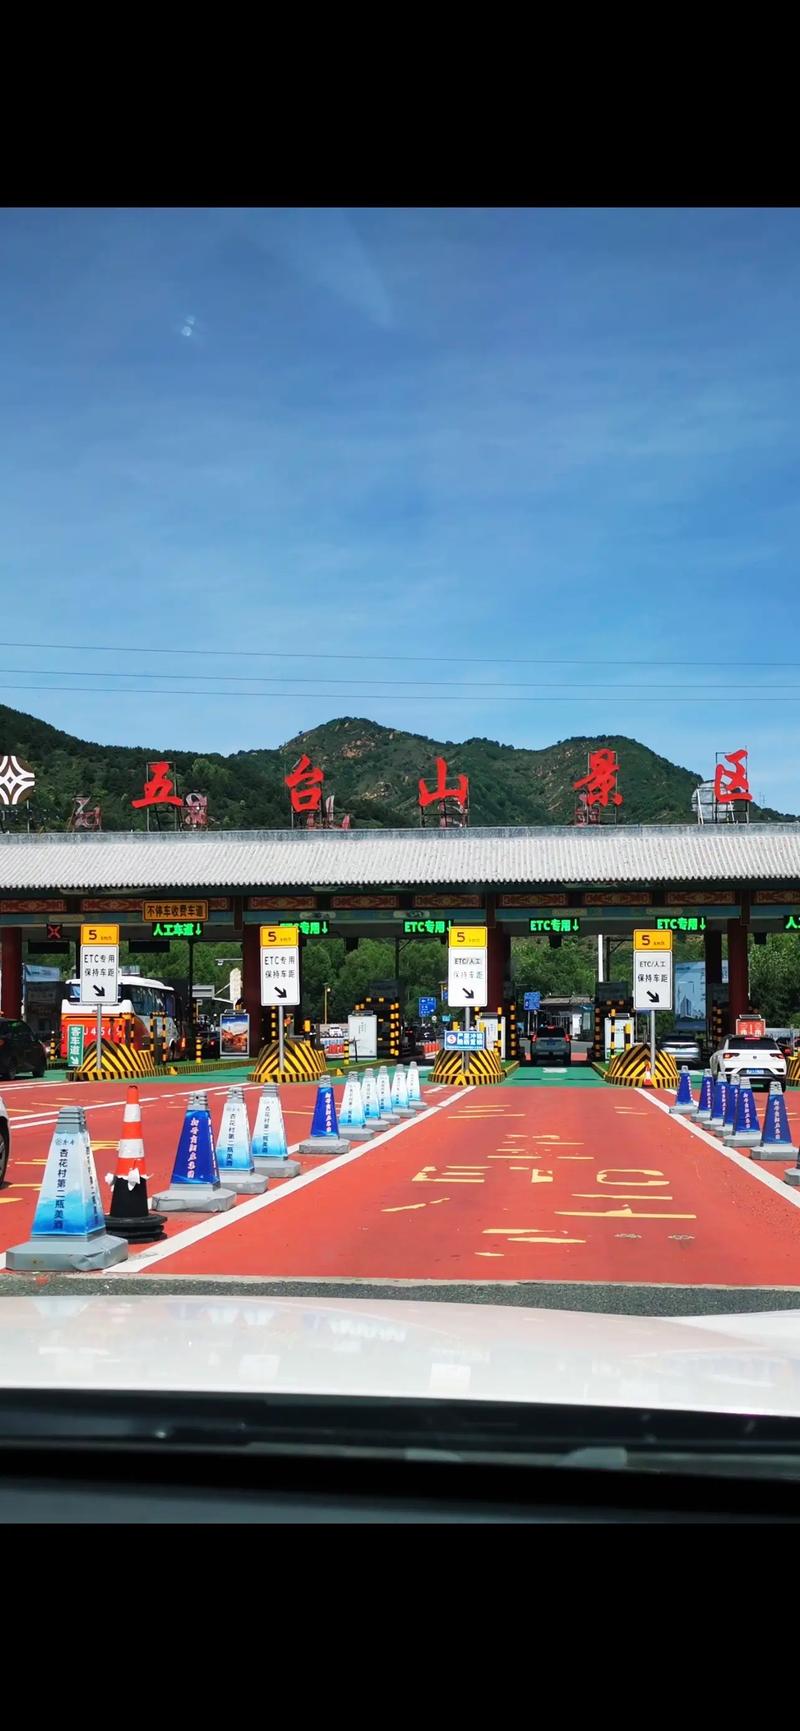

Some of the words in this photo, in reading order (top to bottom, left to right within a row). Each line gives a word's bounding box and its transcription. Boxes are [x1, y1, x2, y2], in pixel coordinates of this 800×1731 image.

[147, 905, 204, 917] 不停车收费车道
[153, 923, 194, 936] 人工车道
[404, 920, 445, 933] ETC专用
[530, 918, 571, 931] ETC专用
[657, 917, 698, 931] ETC专用
[89, 930, 98, 941] 5
[268, 931, 277, 942] 5
[456, 931, 466, 943] 5
[641, 935, 651, 946] 5
[84, 955, 115, 963] ETC专用
[264, 956, 295, 965] ETC专用
[85, 968, 115, 977] 保持车距
[637, 973, 669, 982] 保持车距
[54, 1149, 69, 1229] 杏花村第二瓶美酒
